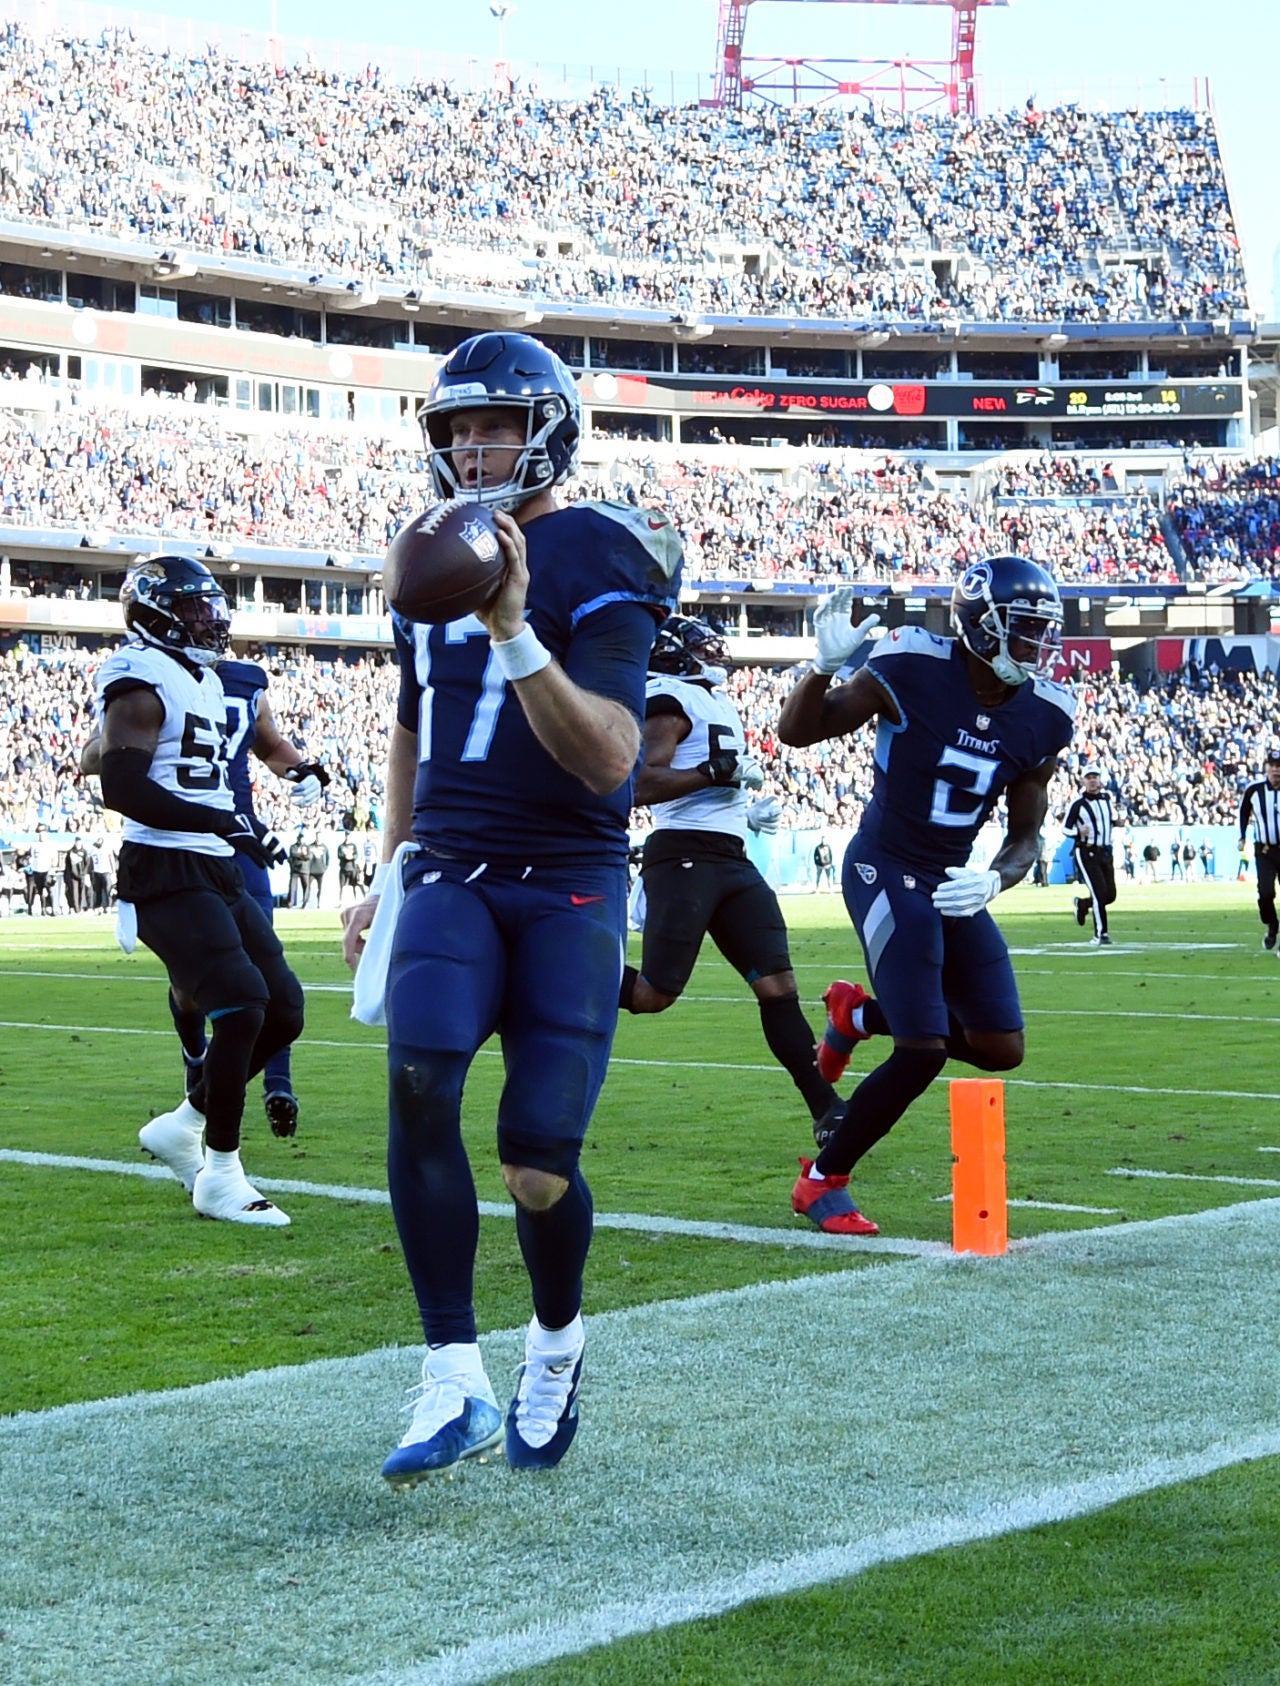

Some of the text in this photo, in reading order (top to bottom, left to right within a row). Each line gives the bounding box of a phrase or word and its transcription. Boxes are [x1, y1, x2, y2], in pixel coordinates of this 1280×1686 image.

[729, 386, 775, 408] Coke
[780, 394, 816, 408] ZERO
[820, 396, 867, 409] SUGAR
[1069, 392, 1087, 404] 20
[41, 635, 77, 649] ELVIN
[413, 613, 506, 762] 17
[956, 728, 1000, 754] TITANS
[928, 745, 1002, 827] 2
